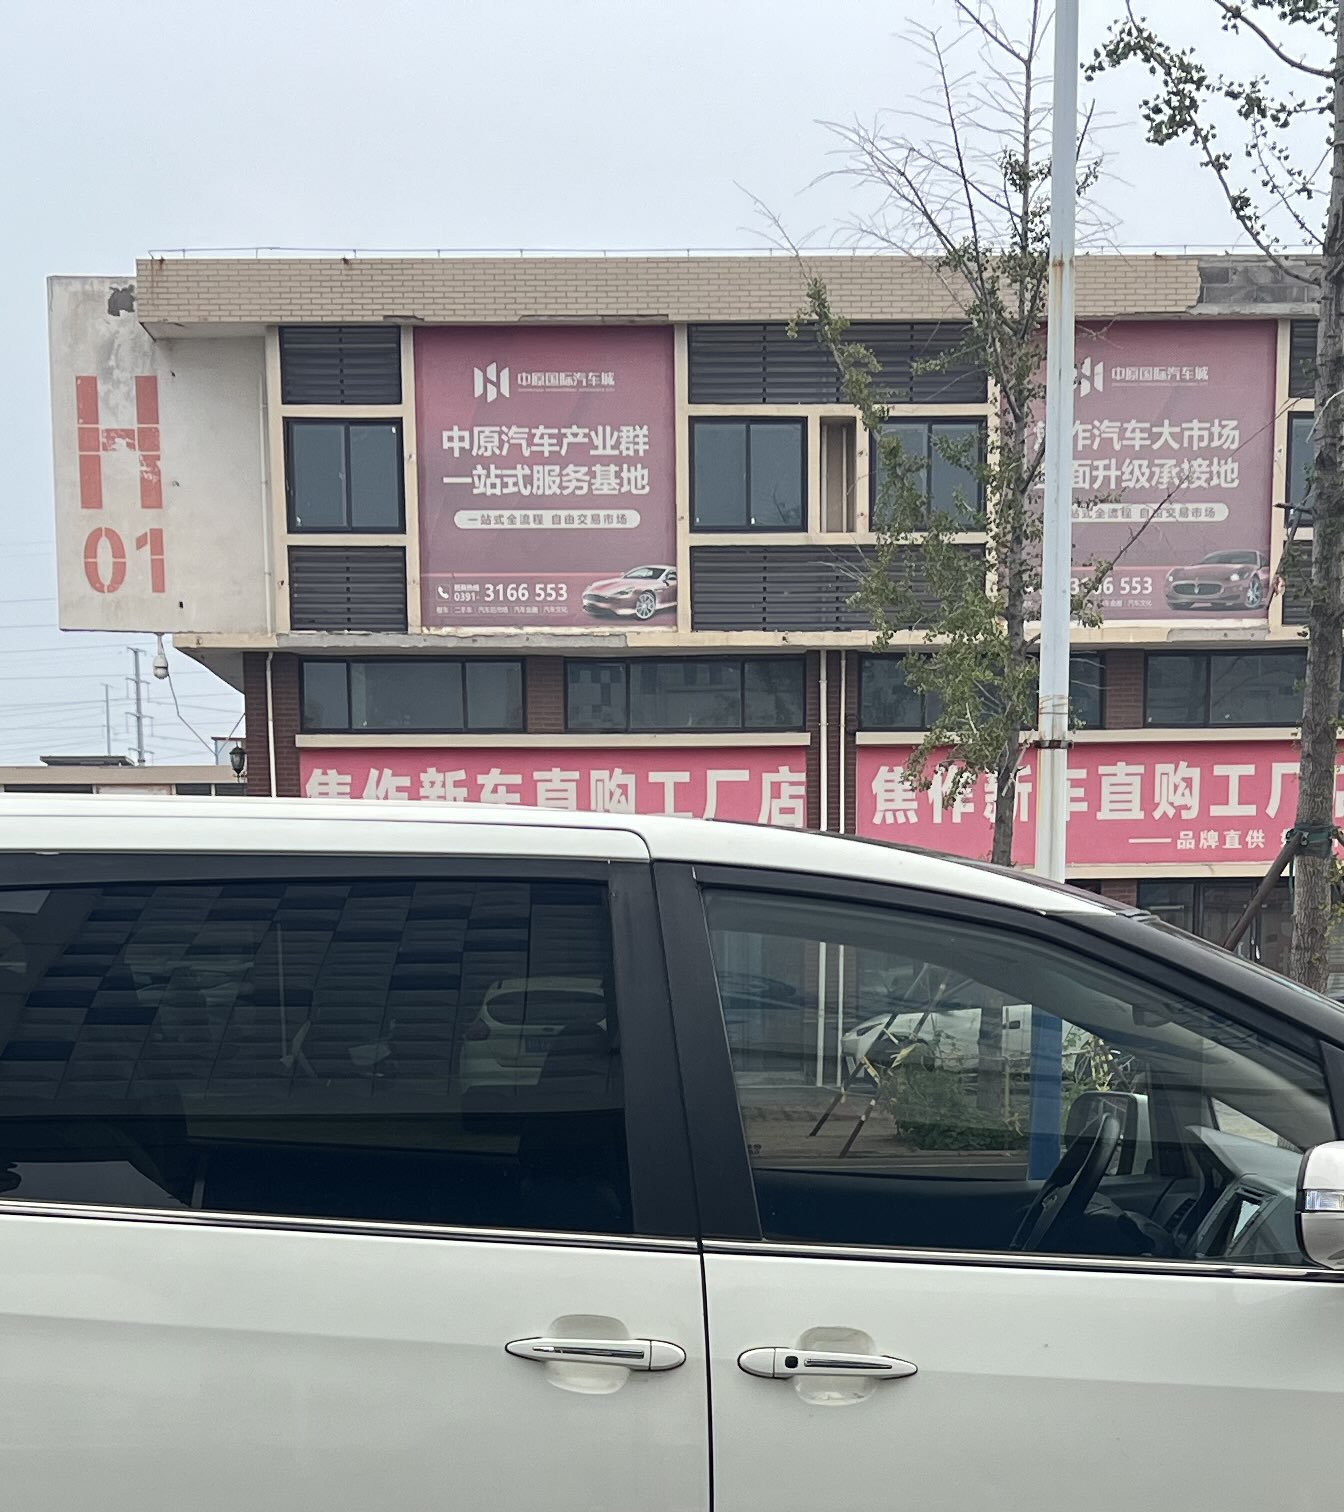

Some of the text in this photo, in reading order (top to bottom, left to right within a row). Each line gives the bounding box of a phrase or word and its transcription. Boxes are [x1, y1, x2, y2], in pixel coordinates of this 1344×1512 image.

[517, 372, 615, 386] 中原国际汽车城
[1111, 366, 1209, 381] 中原国际汽车城
[76, 375, 163, 509] H
[442, 425, 649, 458] 中原汽车产业群
[1033, 418, 1240, 451] 作汽车大市场
[443, 463, 650, 496] 一站式服务基地
[1033, 456, 1240, 490] 面升级承接地
[467, 513, 627, 526] 一站式全流程 自由交易市场
[84, 527, 165, 593] 01
[484, 583, 529, 601] 3166
[535, 583, 568, 601] 553
[1120, 577, 1153, 595] 553
